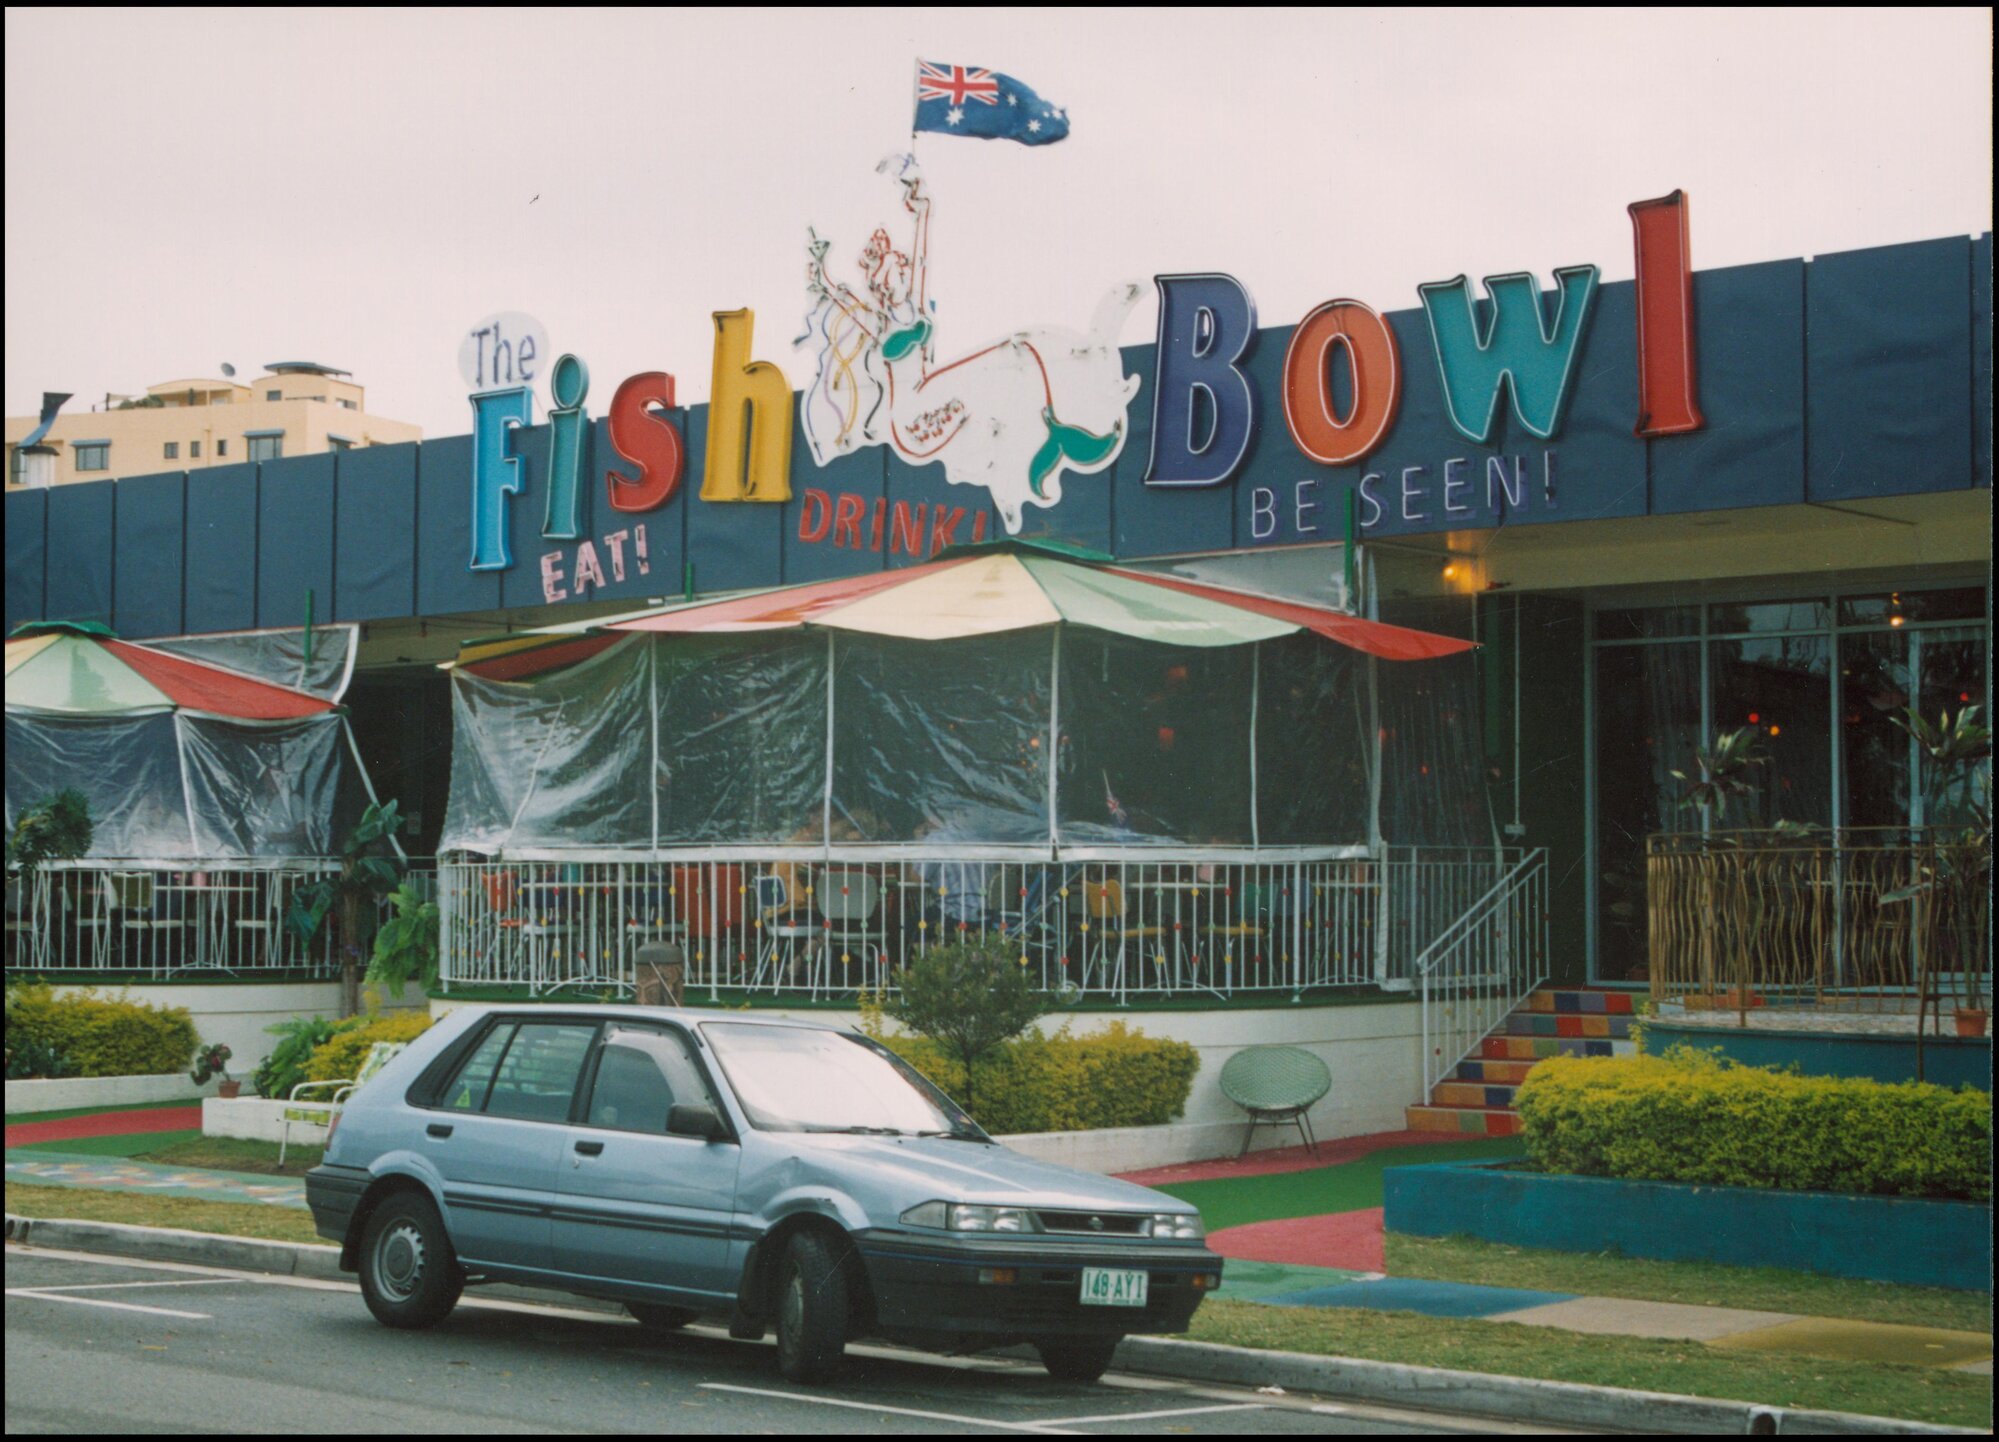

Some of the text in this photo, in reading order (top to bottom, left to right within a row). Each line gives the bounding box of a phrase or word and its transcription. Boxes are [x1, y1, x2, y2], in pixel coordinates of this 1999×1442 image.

[466, 188, 1704, 571] Fish Bowl
[471, 320, 536, 388] The
[798, 487, 988, 560] DRINK!
[1252, 450, 1560, 540] BE SEEN!
[540, 523, 649, 604] EAT!
